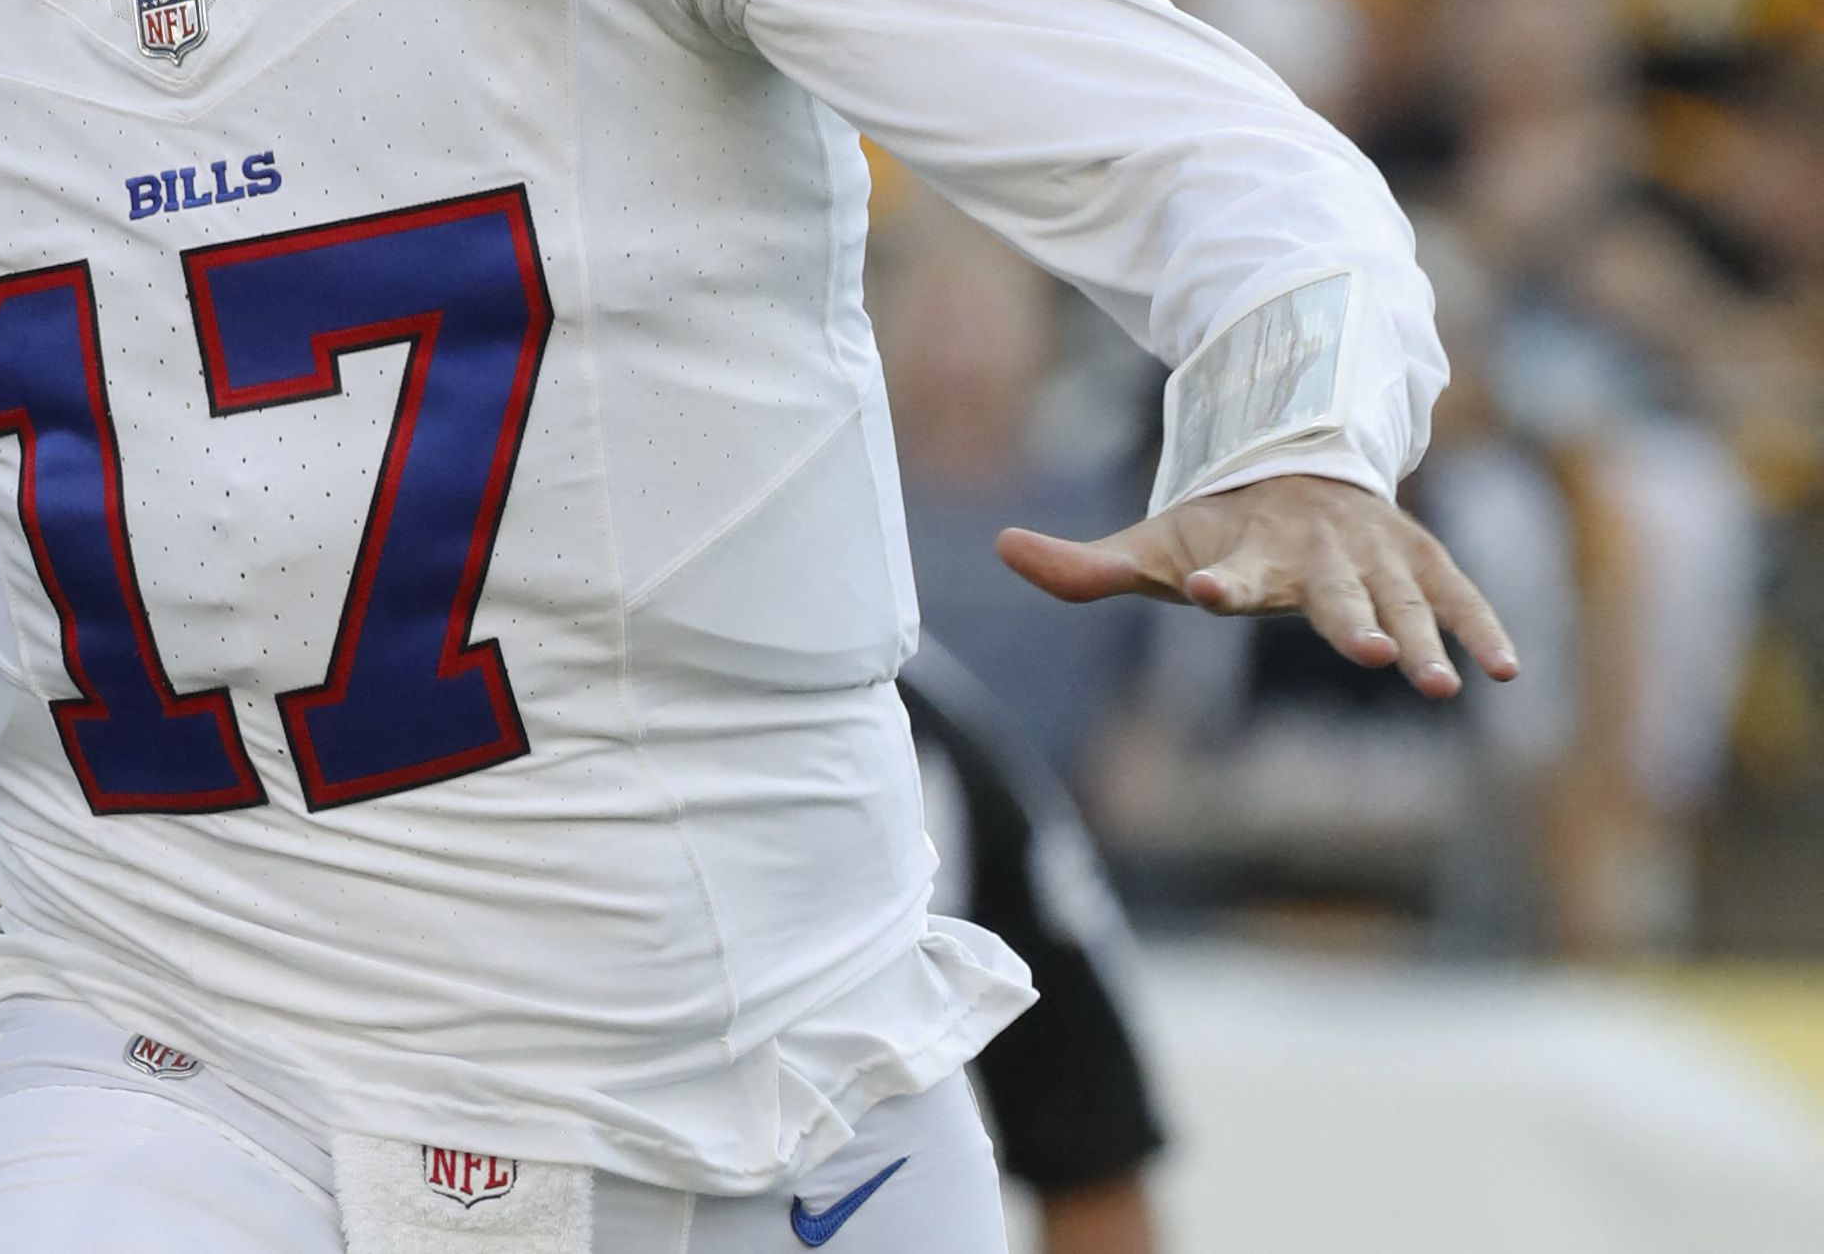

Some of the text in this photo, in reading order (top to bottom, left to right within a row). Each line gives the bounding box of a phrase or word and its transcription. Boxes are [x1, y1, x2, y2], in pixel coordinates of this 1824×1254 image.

[145, 4, 195, 45] NFL
[125, 150, 282, 221] BILLS
[428, 1146, 509, 1197] NFL
